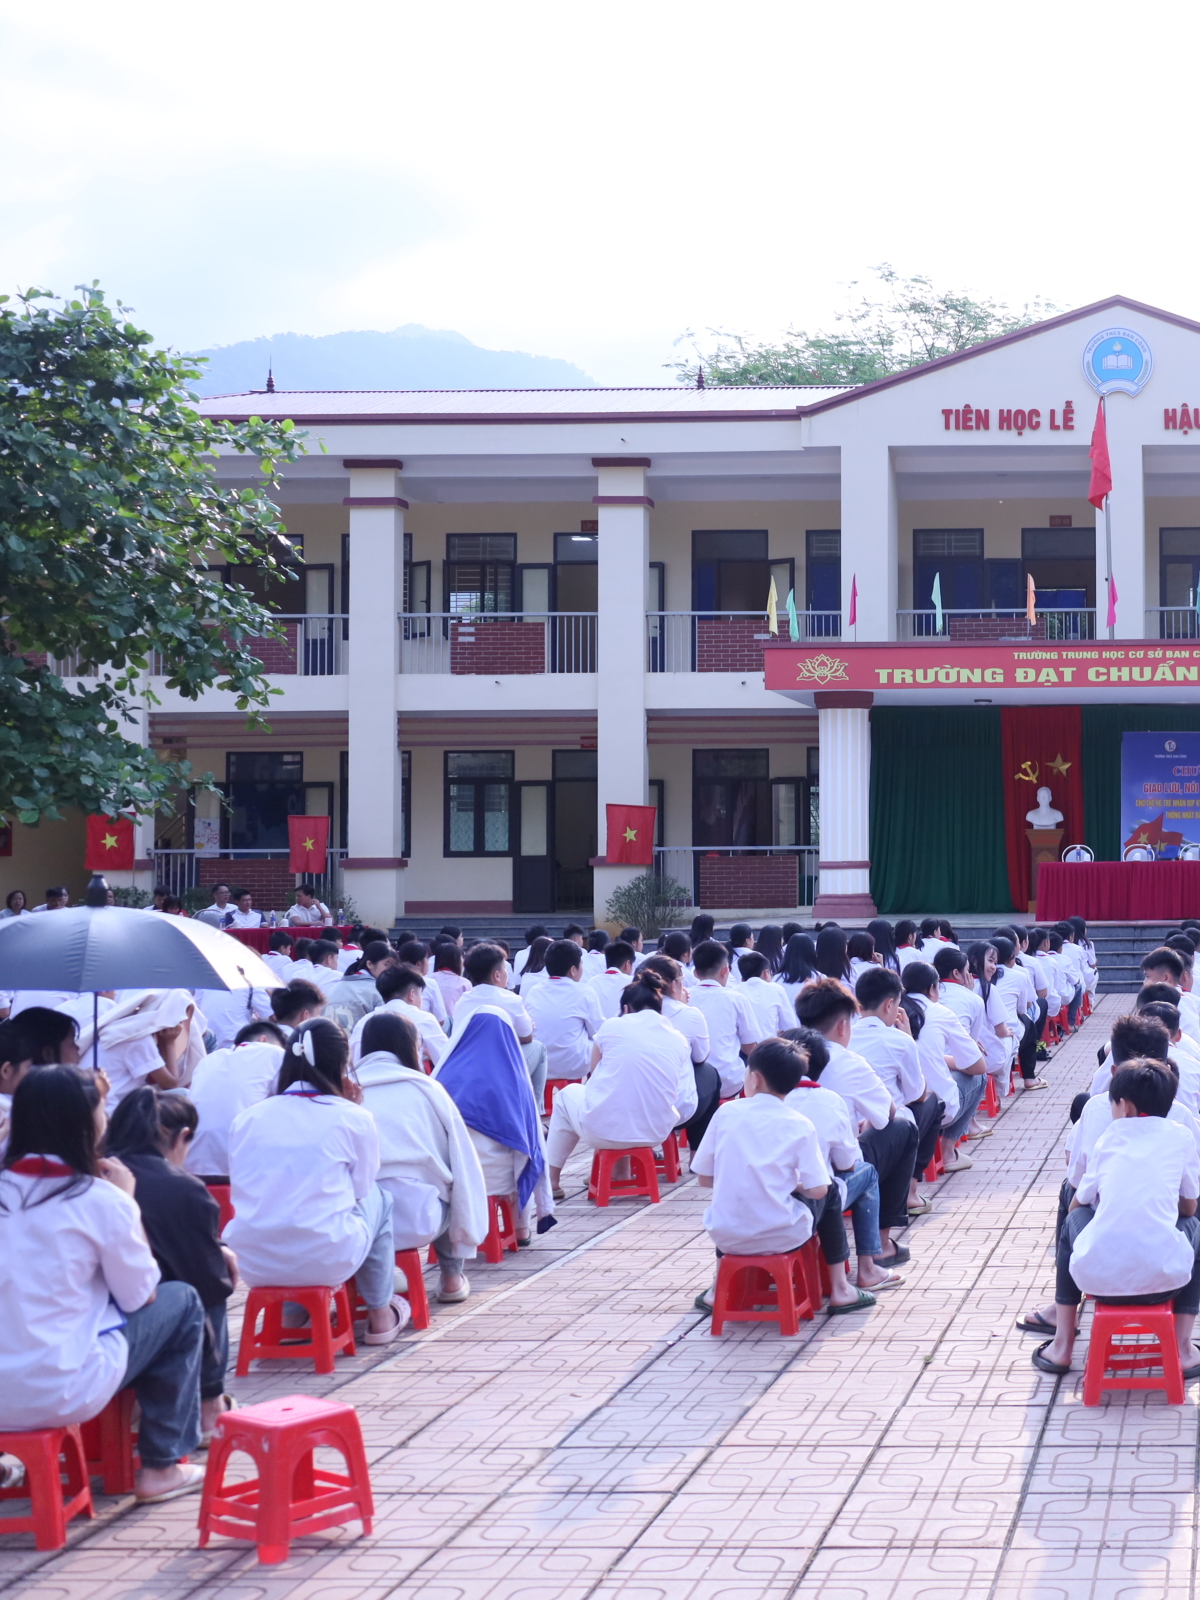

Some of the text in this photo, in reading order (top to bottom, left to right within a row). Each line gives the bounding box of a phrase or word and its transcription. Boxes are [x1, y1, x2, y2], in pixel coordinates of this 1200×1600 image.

[1105, 330, 1121, 338] THCS
[1122, 331, 1135, 340] BAN
[941, 400, 1075, 436] TIÊN HỌC LỄ
[1013, 651, 1058, 660] TRƯỜNG
[1061, 651, 1099, 659] TRUNG
[1102, 650, 1126, 660] HỌC
[1128, 650, 1144, 659] CƠ
[1147, 648, 1163, 659] SỞ
[1166, 650, 1190, 658] BAN
[874, 664, 1004, 684] TRƯỜNG
[1014, 667, 1077, 686] ĐẠT
[1087, 660, 1198, 682] CHUẨN
[1143, 782, 1163, 794] GIAO
[1184, 780, 1199, 794] NÓI
